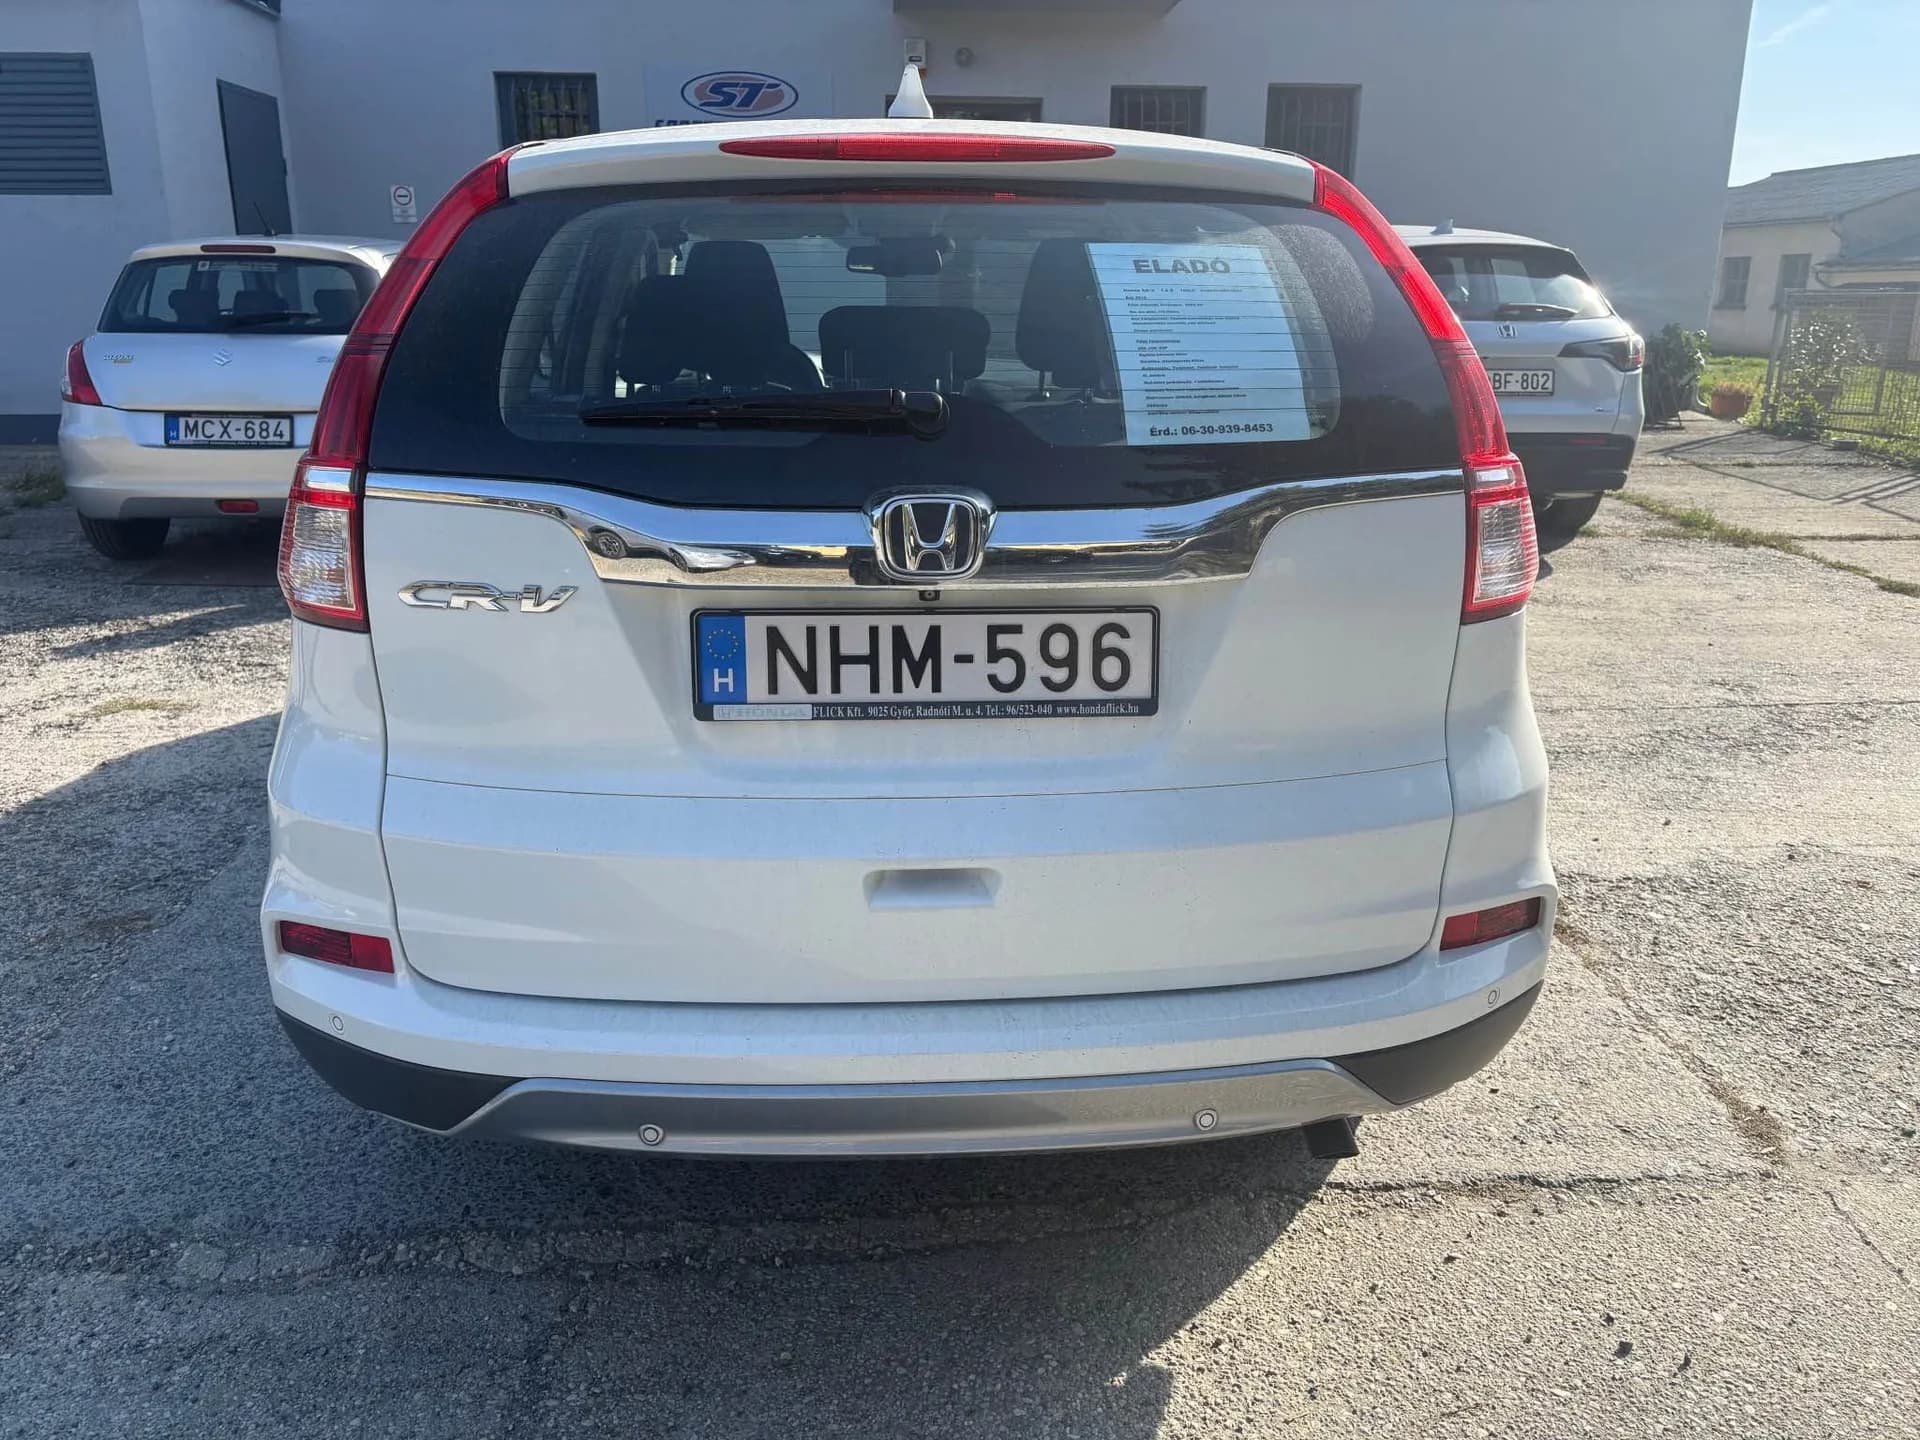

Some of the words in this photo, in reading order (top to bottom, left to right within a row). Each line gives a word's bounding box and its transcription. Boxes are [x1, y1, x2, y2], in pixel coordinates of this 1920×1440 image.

[184, 419, 284, 440] MCX-684
[1150, 424, 1178, 437] Érd.:
[1181, 423, 1274, 436] 06-30-939-8453
[398, 580, 580, 613] CR-V
[766, 622, 1132, 695] NHM-596
[713, 668, 734, 693] H
[813, 706, 844, 718] FLICK
[847, 706, 864, 718] Kft.
[867, 706, 888, 717] 9025
[916, 705, 950, 717] Radnóti
[952, 705, 964, 716] M.
[985, 704, 1004, 716] Tel.:
[1006, 704, 1053, 715] 96/523-040
[1057, 703, 1139, 715] www.hondaflick.hu
